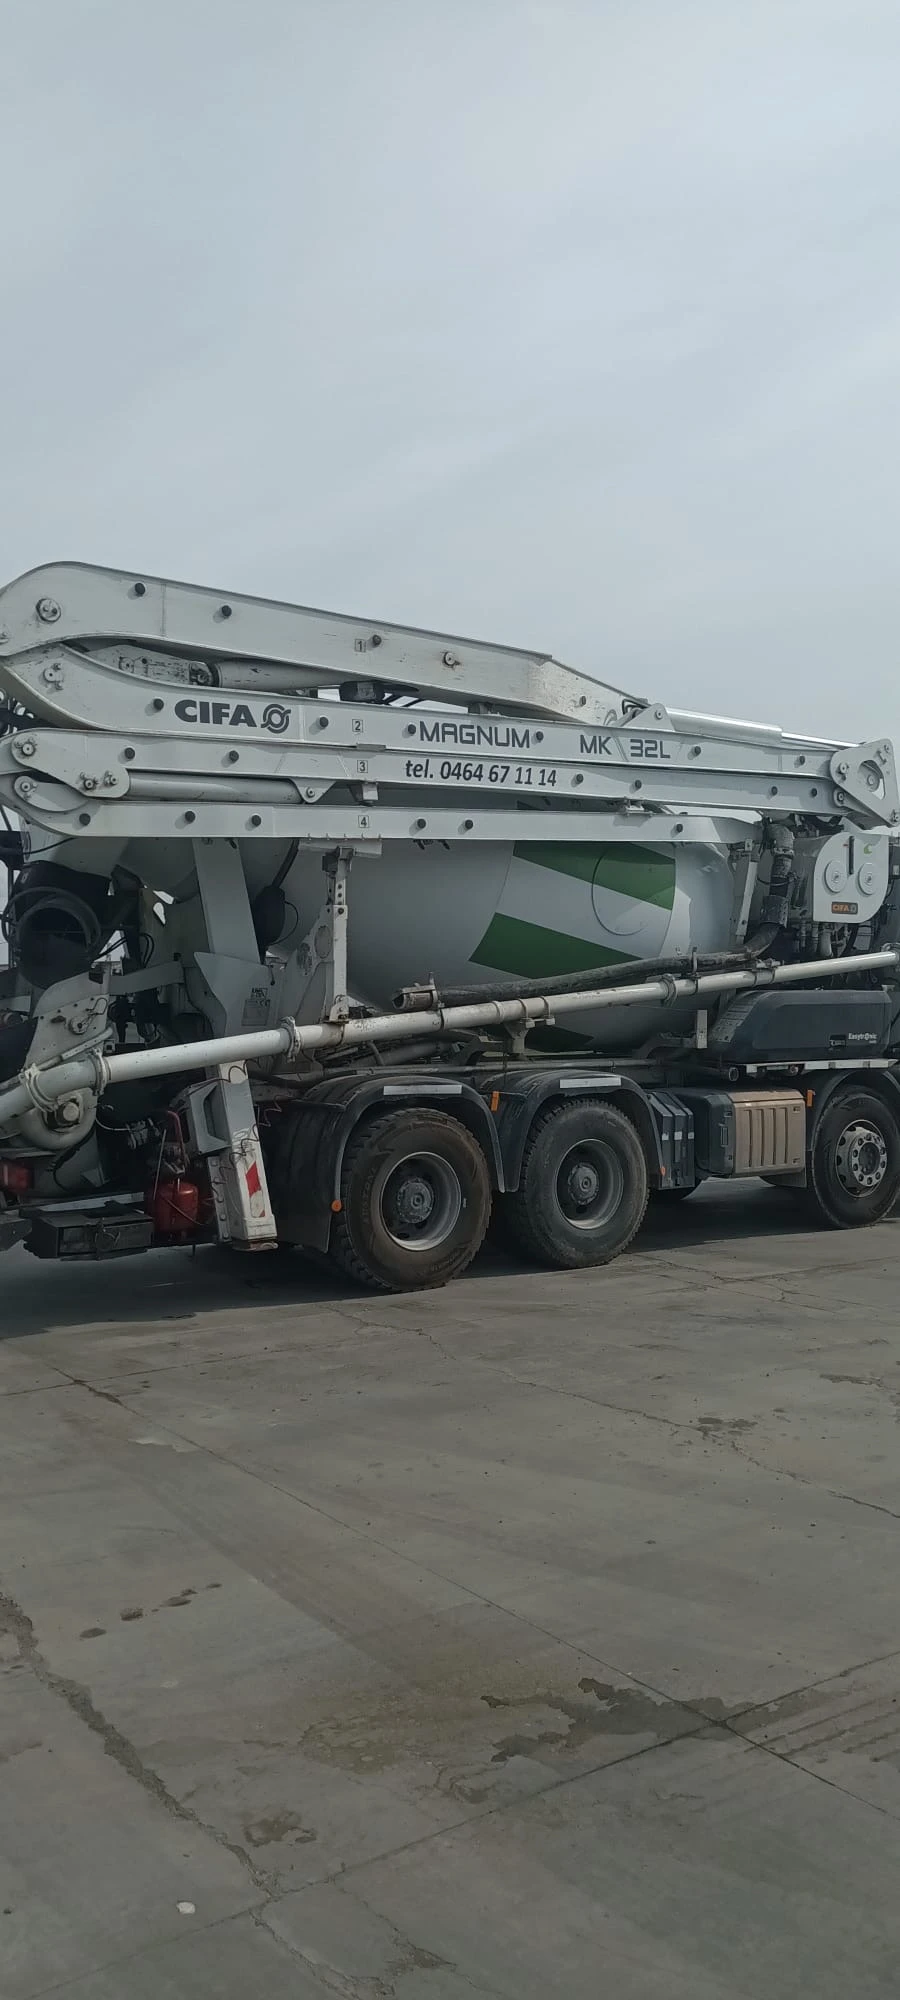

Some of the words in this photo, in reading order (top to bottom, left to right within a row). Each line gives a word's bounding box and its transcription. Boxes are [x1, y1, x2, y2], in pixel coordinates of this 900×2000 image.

[174, 699, 257, 728] CIFA
[419, 721, 530, 749] MAGNUM
[579, 734, 612, 755] MK
[630, 738, 671, 759] 32L
[405, 759, 434, 779] tel.
[440, 761, 483, 782] 0464
[488, 765, 510, 783] 67
[514, 766, 533, 785] 11
[538, 768, 557, 787] 14
